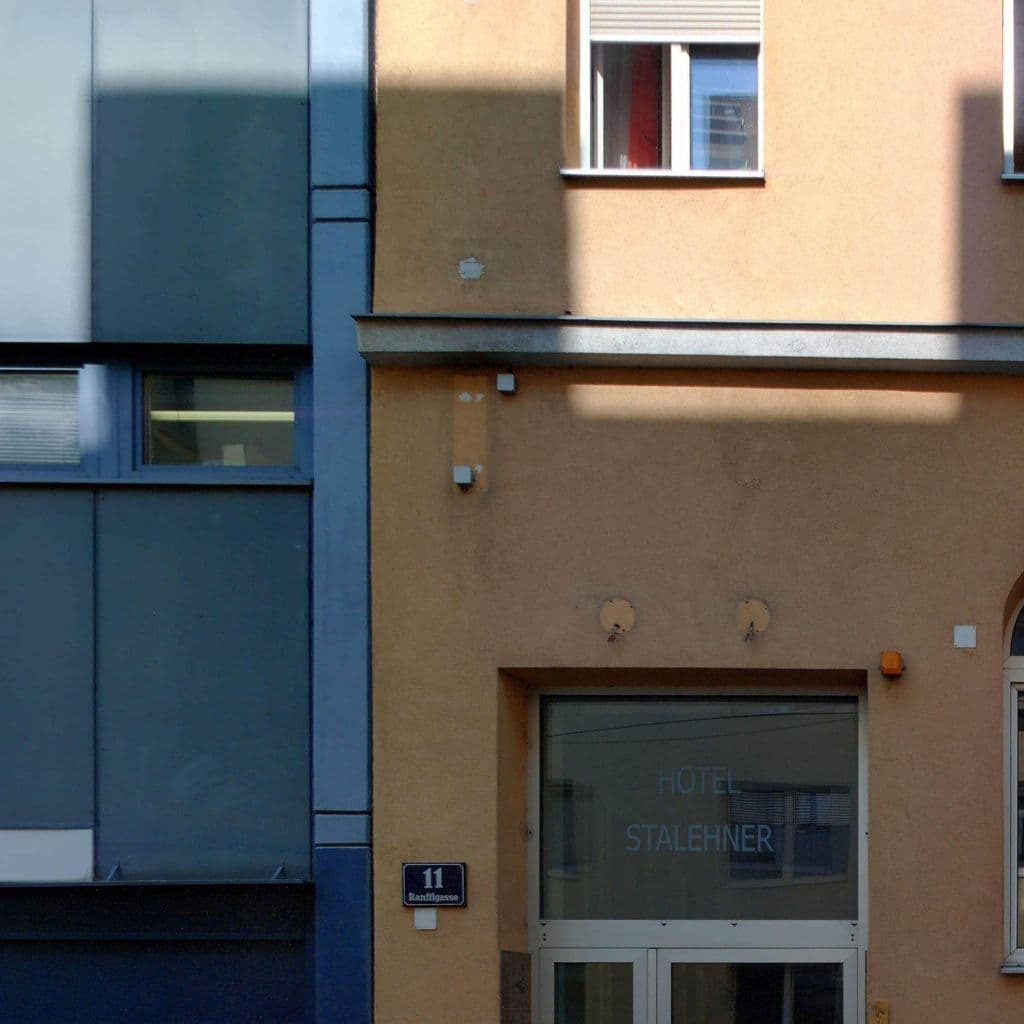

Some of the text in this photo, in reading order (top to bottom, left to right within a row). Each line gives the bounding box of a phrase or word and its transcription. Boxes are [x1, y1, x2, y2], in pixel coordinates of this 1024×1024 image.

[658, 767, 741, 794] HOTEL
[625, 823, 774, 852] STALEHNER
[422, 867, 443, 889] 11
